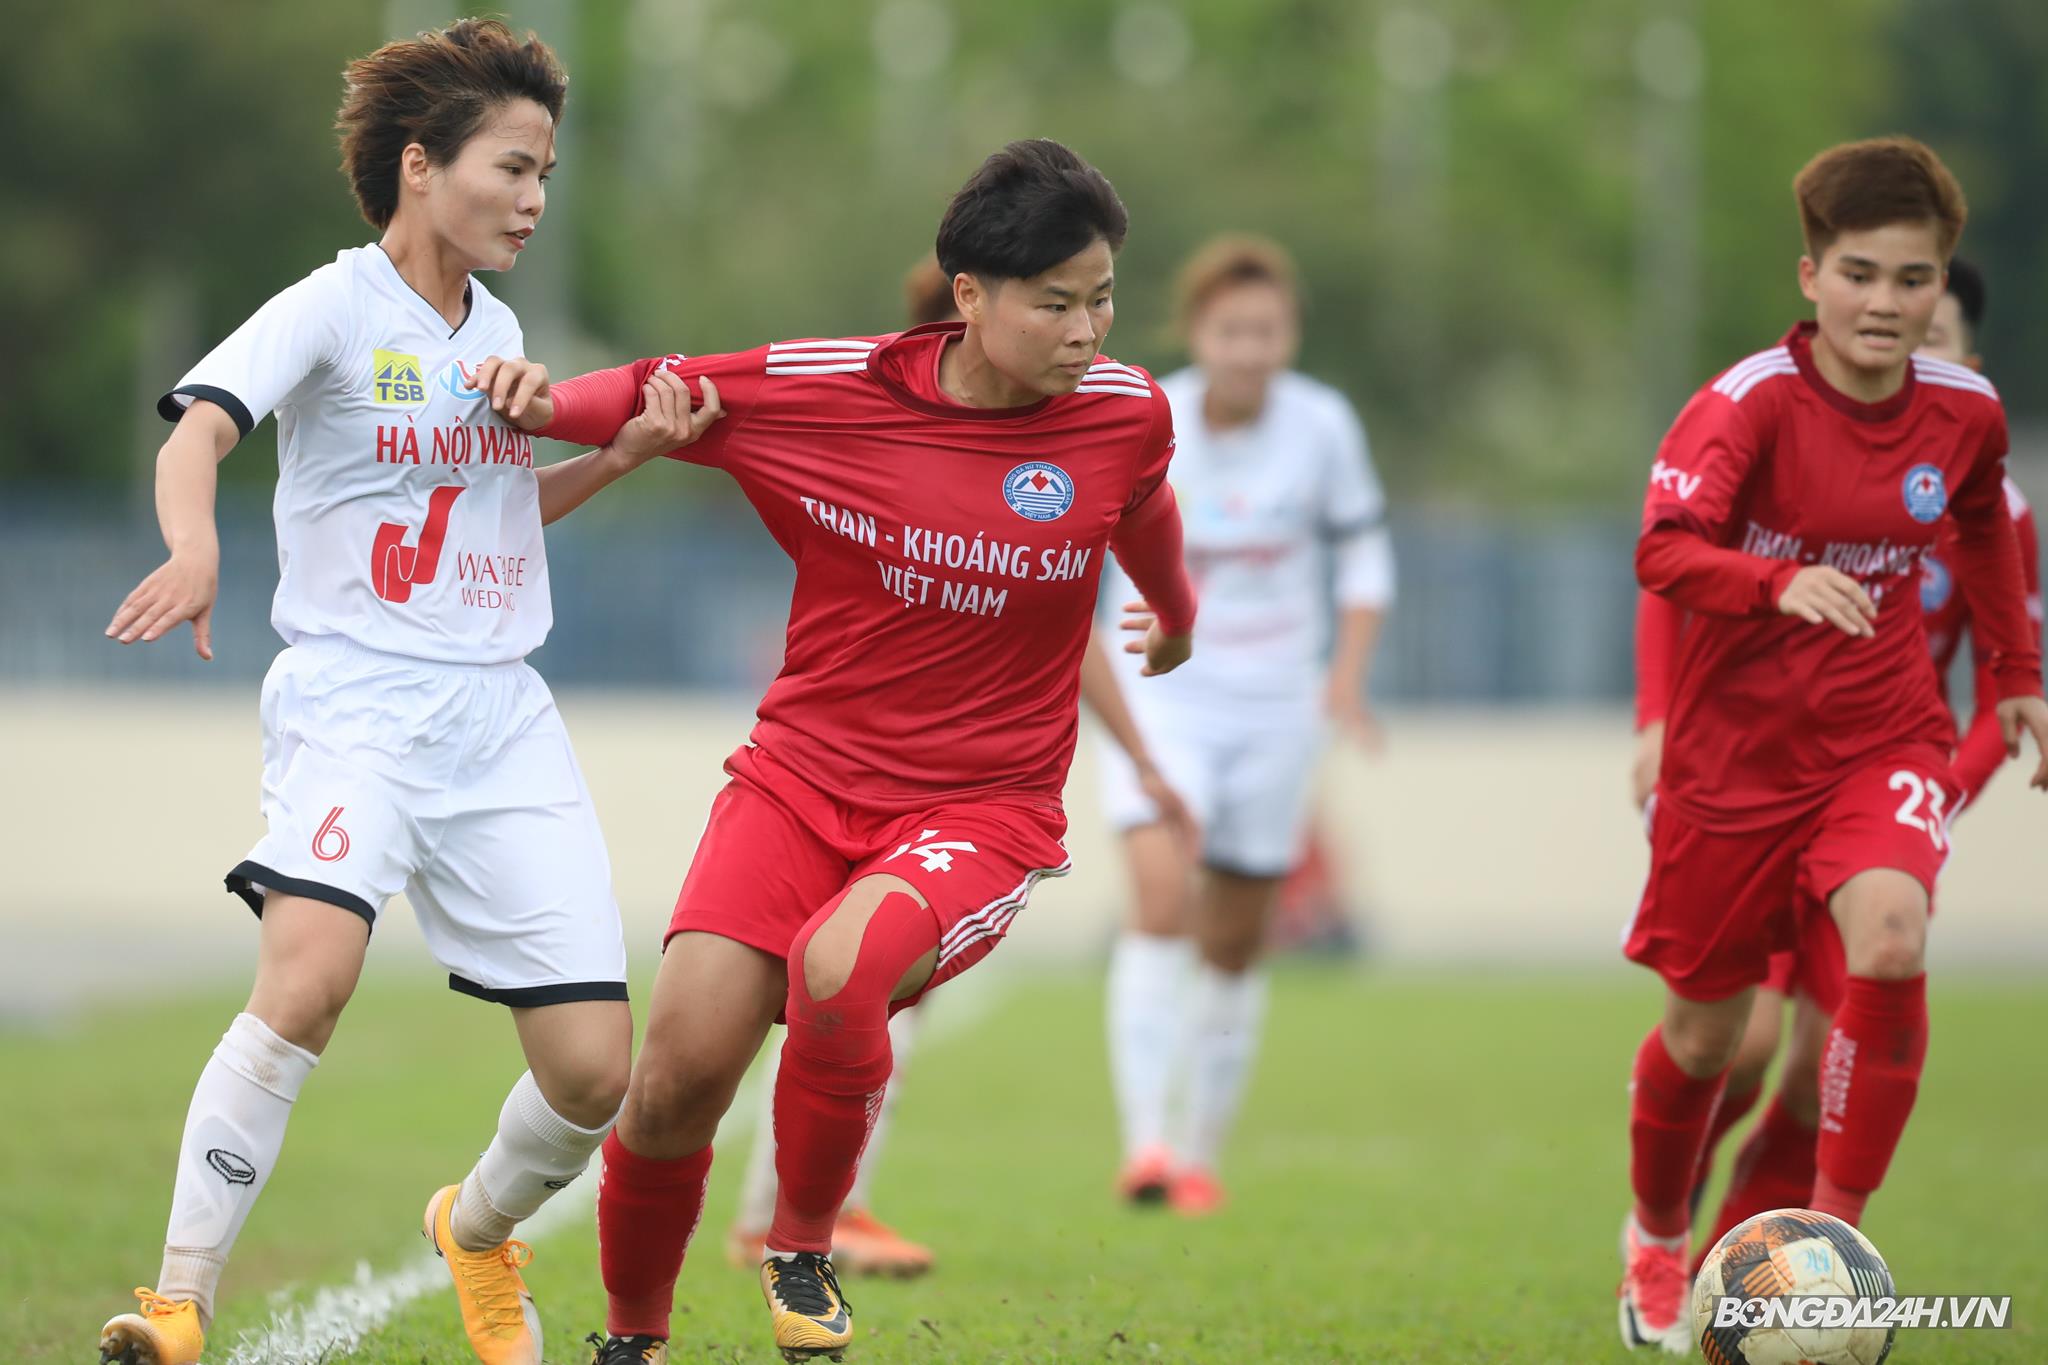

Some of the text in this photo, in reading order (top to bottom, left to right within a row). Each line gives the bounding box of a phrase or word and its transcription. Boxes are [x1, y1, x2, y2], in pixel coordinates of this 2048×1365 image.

[377, 381, 425, 401] TSB
[376, 414, 421, 465] HÀ
[431, 415, 472, 473] NỘI
[800, 496, 877, 548] THAN
[903, 525, 1031, 579] KHOÁNG
[1036, 540, 1091, 582] SẢN
[1743, 520, 1802, 560] THAN
[877, 561, 1008, 618] VIỆT NAM
[311, 806, 350, 863] 6
[1888, 769, 1946, 850] 23
